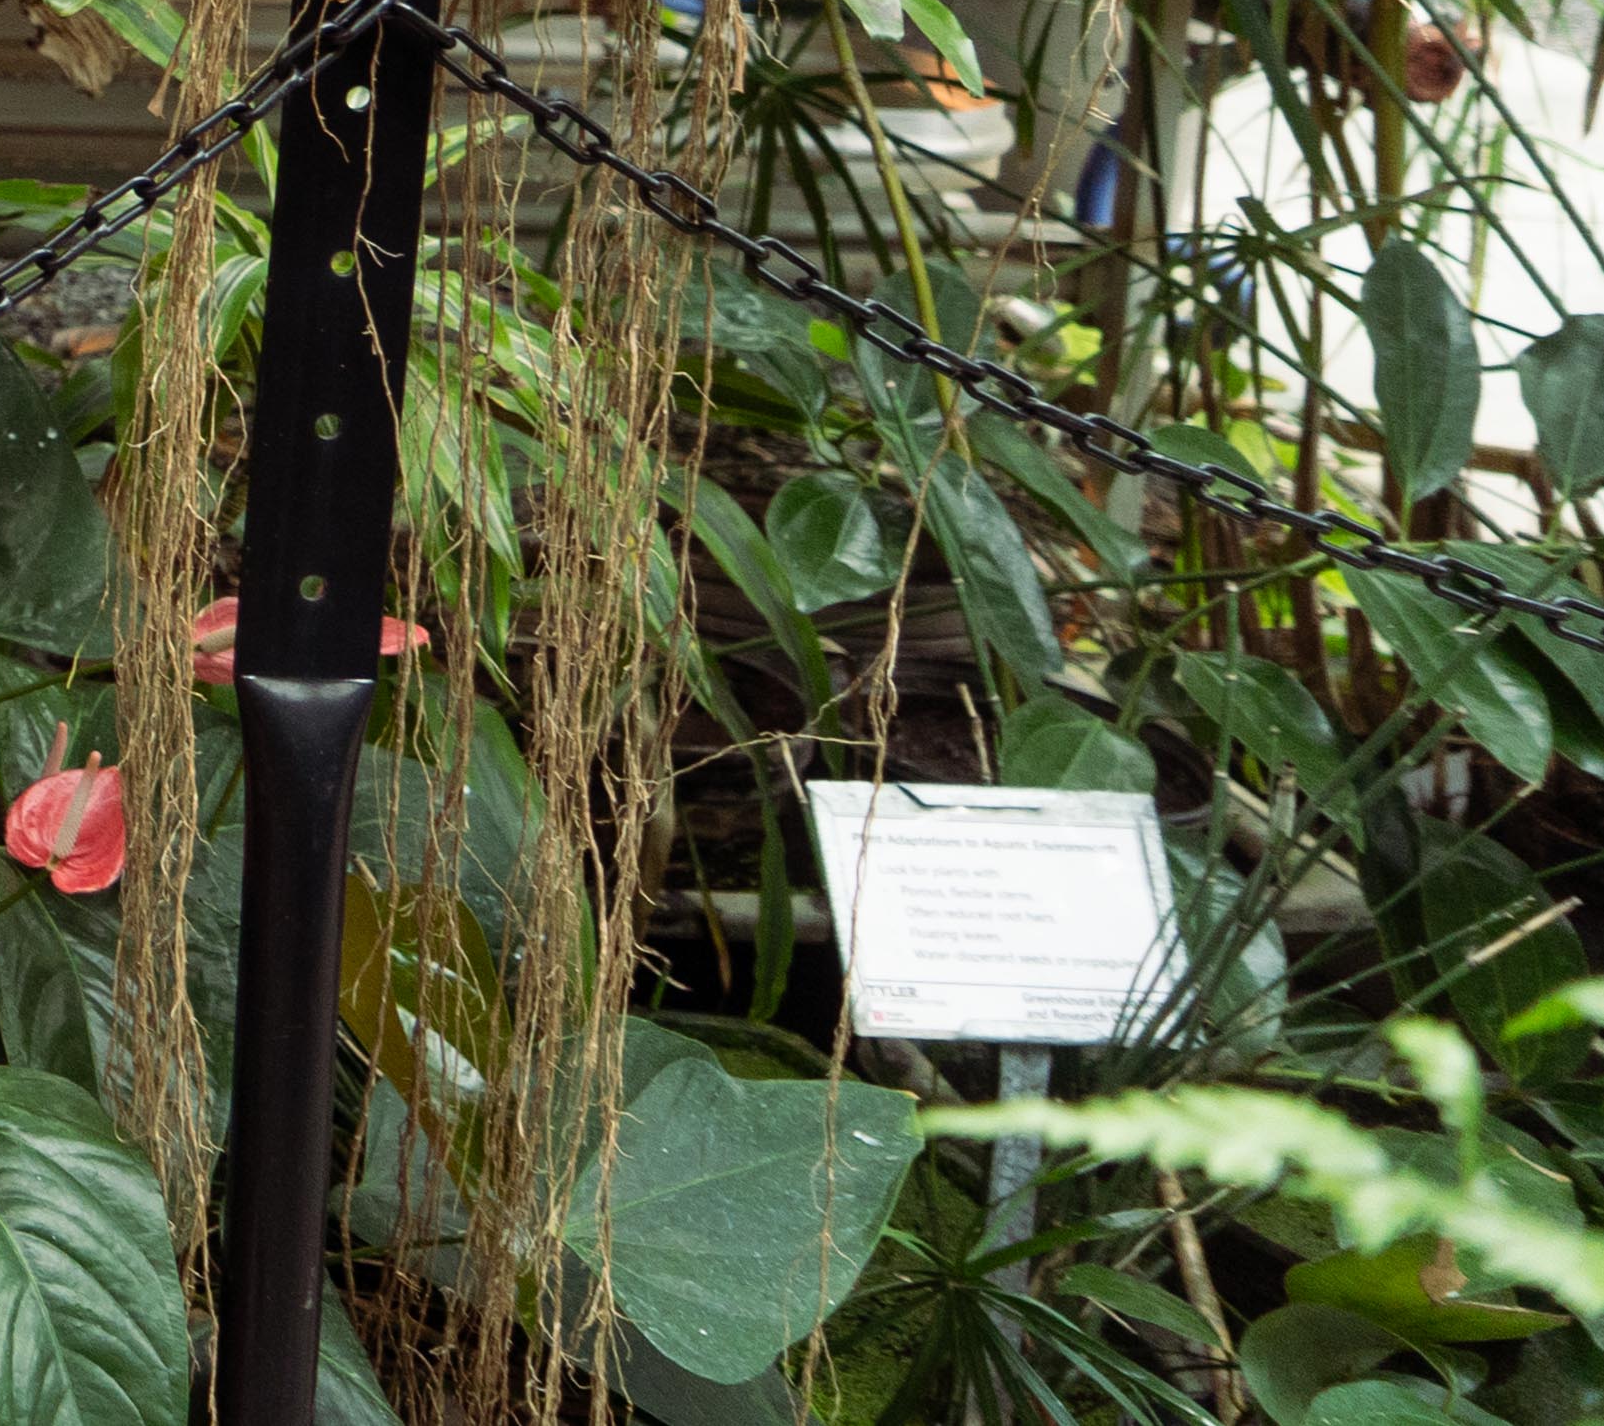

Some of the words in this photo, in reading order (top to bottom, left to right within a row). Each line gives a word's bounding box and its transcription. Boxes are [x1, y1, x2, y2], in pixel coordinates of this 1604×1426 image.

[887, 834, 962, 848] Adaptations
[965, 837, 979, 848] to
[867, 985, 918, 998] TYLER
[1022, 992, 1095, 1007] Greenhouse
